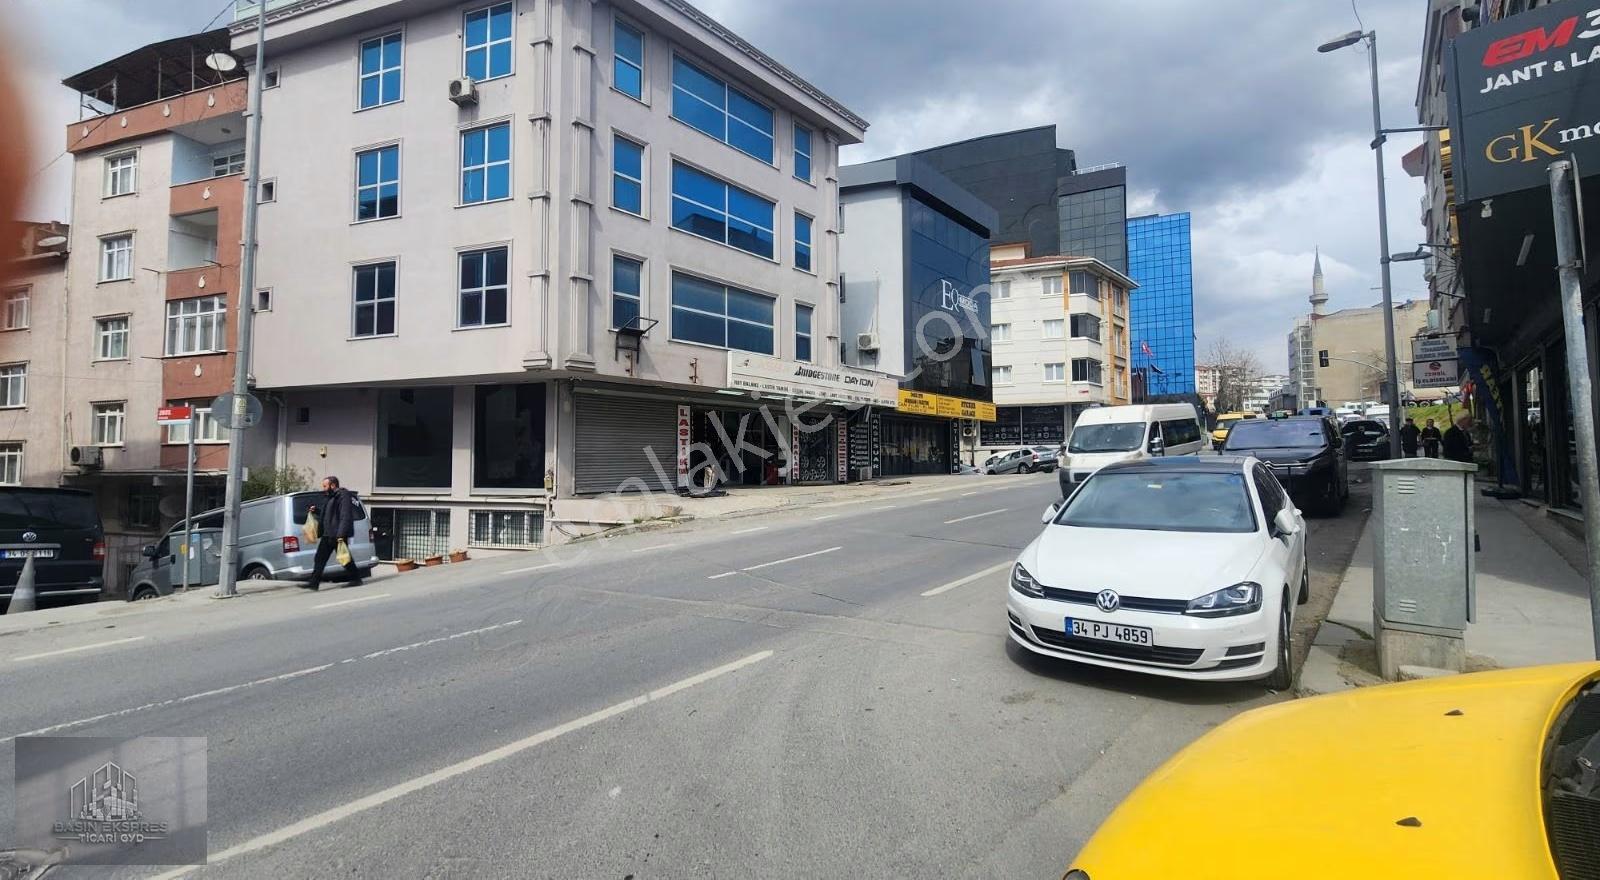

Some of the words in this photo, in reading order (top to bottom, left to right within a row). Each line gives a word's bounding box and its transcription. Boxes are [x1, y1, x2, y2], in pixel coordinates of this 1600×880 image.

[1480, 61, 1547, 94] JANT
[1553, 60, 1565, 72] &
[1485, 118, 1565, 163] GK
[794, 366, 840, 380] BRIDGESTONE
[844, 376, 874, 387] DAYTON
[872, 419, 880, 469] AKSESUAR
[1074, 621, 1088, 636] 34
[1093, 623, 1109, 638] PJ
[1115, 627, 1148, 644] 4859
